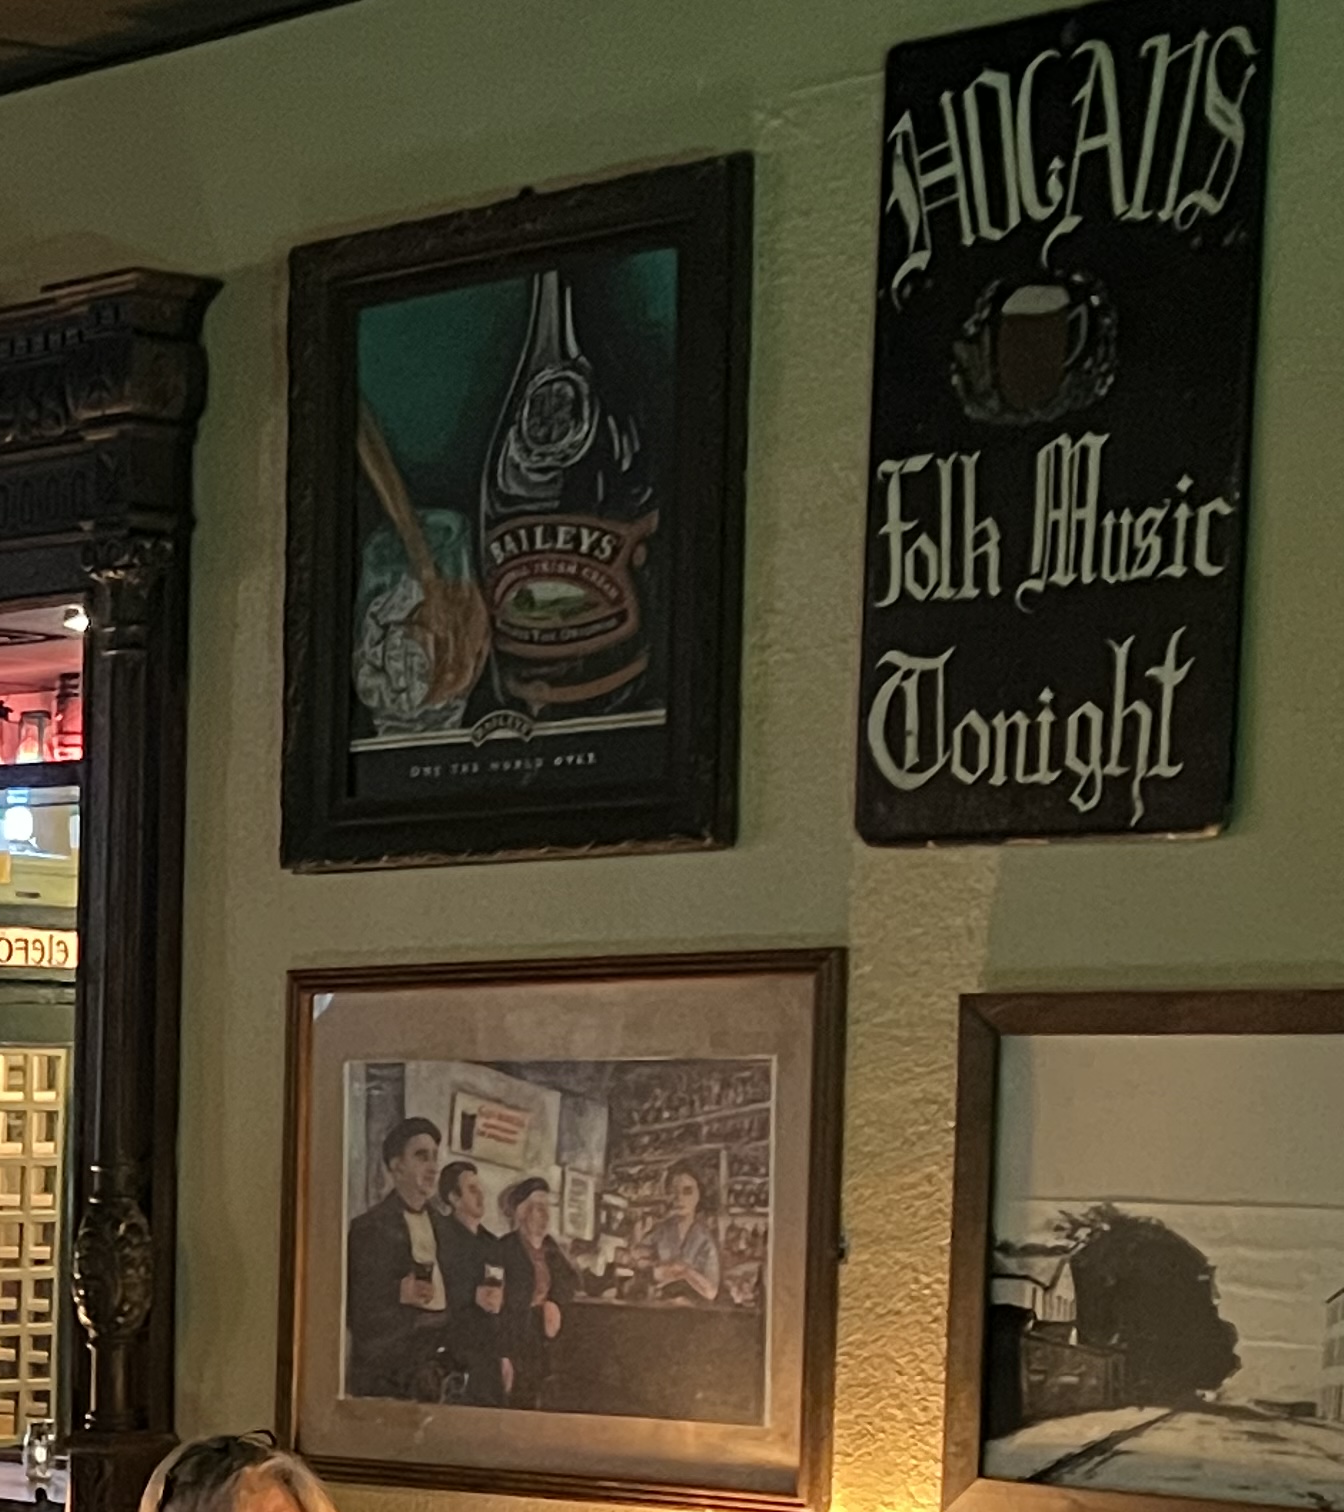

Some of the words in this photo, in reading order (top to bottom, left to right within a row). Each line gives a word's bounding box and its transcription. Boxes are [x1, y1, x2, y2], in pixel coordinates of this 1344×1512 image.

[490, 525, 617, 565] BAILEYS
[874, 450, 1002, 609] Folk
[1015, 431, 1236, 614] Music
[867, 625, 1196, 827] Tonight
